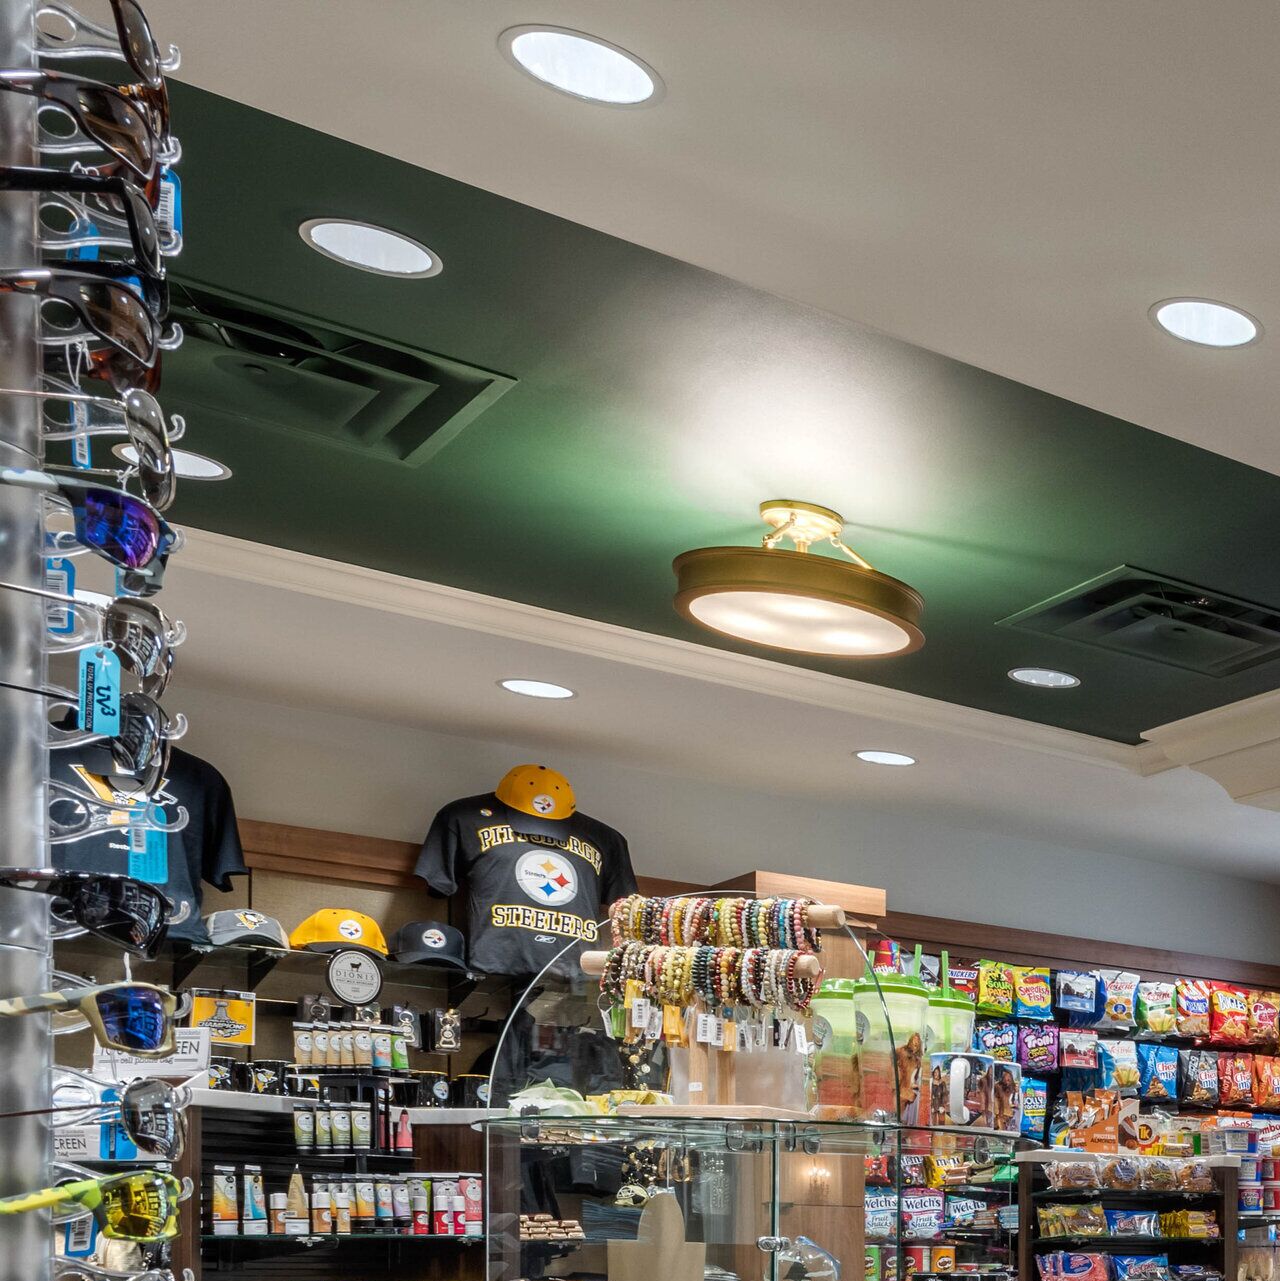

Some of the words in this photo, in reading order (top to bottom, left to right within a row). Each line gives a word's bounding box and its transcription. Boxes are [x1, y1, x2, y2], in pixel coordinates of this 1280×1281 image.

[95, 684, 117, 718] UV3
[109, 841, 130, 851] Reeb
[492, 904, 598, 942] STEELERS
[336, 970, 375, 980] DIONIS
[947, 970, 977, 980] SNICKERS
[987, 979, 1013, 990] SOUR
[1018, 986, 1051, 997] Swedish
[1028, 993, 1046, 1003] Fish
[1217, 991, 1248, 1013] BUGLES
[983, 1032, 1014, 1048] Trolli
[1023, 1032, 1055, 1048] Trolli
[1156, 1061, 1178, 1072] Chex
[1199, 1071, 1217, 1082] Chex
[1233, 1072, 1251, 1084] Che
[1237, 1080, 1251, 1091] mi
[54, 1138, 88, 1151] CREEN
[905, 1196, 941, 1209] Welch's
[952, 1200, 987, 1214] Welch's
[915, 1214, 934, 1224] Fruit
